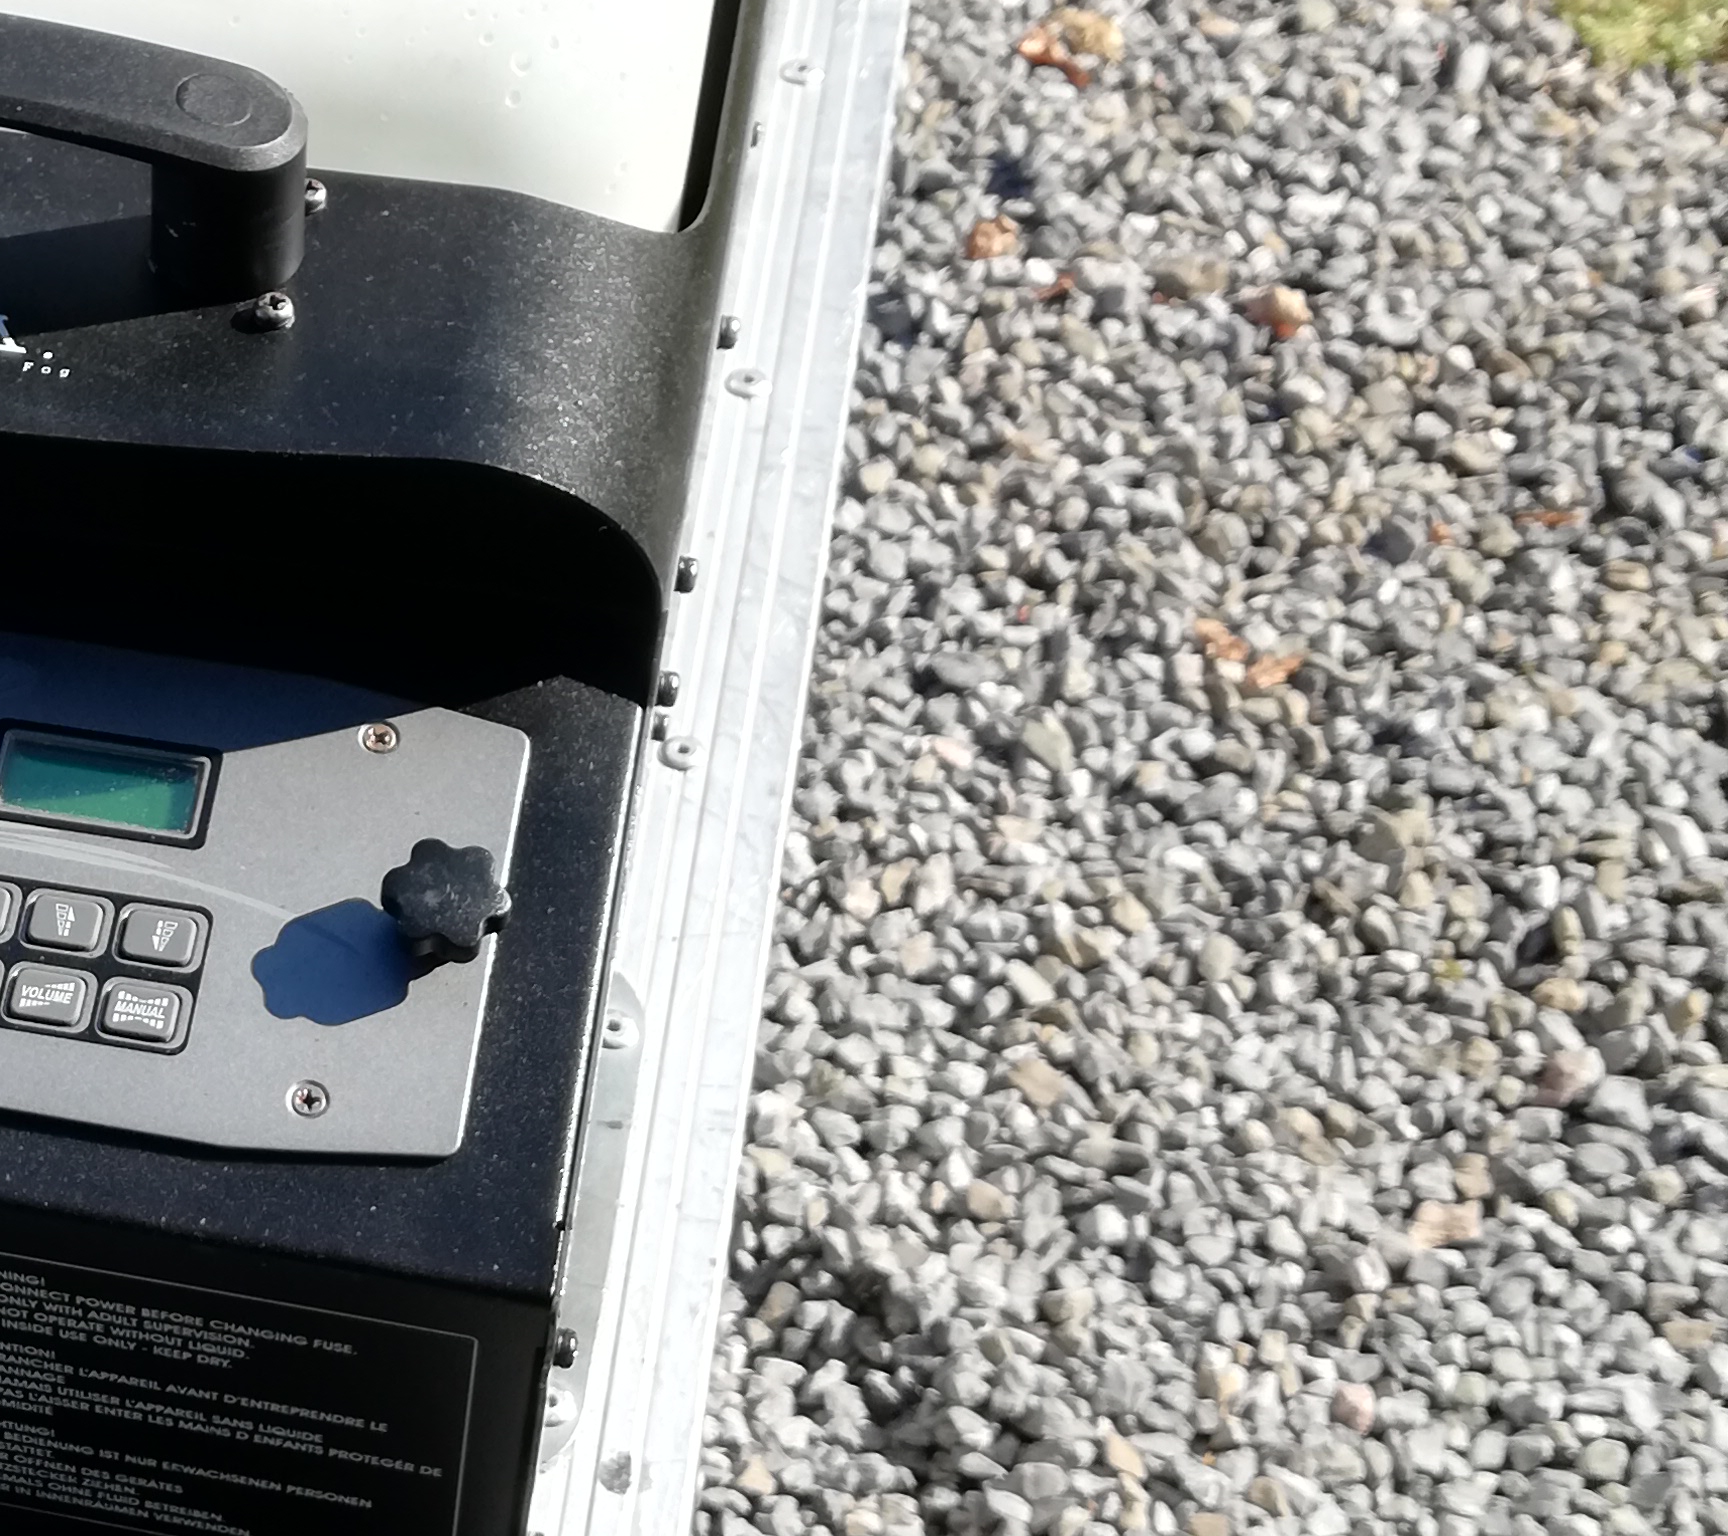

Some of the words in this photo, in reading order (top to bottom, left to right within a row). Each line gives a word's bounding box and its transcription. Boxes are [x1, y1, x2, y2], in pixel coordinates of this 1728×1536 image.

[23, 360, 71, 380] Fog
[21, 984, 74, 1006] VOLUME
[114, 999, 166, 1020] MANUAL
[0, 1317, 54, 1337] INSIDE
[57, 1327, 88, 1343] USE
[91, 1333, 138, 1351] ONLY
[151, 1344, 193, 1361] KEEP
[195, 1352, 232, 1368] DRY.
[31, 1311, 105, 1334] OPERATE
[108, 1325, 183, 1348] WITHOUT
[186, 1338, 249, 1359] LIQUID.
[41, 1301, 84, 1318] WITH
[85, 1308, 138, 1328] ADULT
[141, 1318, 255, 1348] SUPERVISION.
[74, 1295, 137, 1316] POWER
[139, 1306, 204, 1327] BEFORE
[208, 1318, 309, 1346] CHANGING
[311, 1336, 358, 1354] FUSE.
[55, 1385, 121, 1406] UTILISER
[210, 1413, 255, 1431] SANS
[256, 1422, 324, 1443] LIQUIDE
[164, 1382, 219, 1402] AVANT
[146, 1413, 175, 1428] LES
[176, 1419, 232, 1438] MAINS
[252, 1433, 325, 1455] ENFANTS
[2, 1431, 95, 1457] BEDIENUNG
[97, 1448, 120, 1461] IST
[284, 1483, 373, 1509] PERSONEN
[79, 1466, 111, 1480] DES
